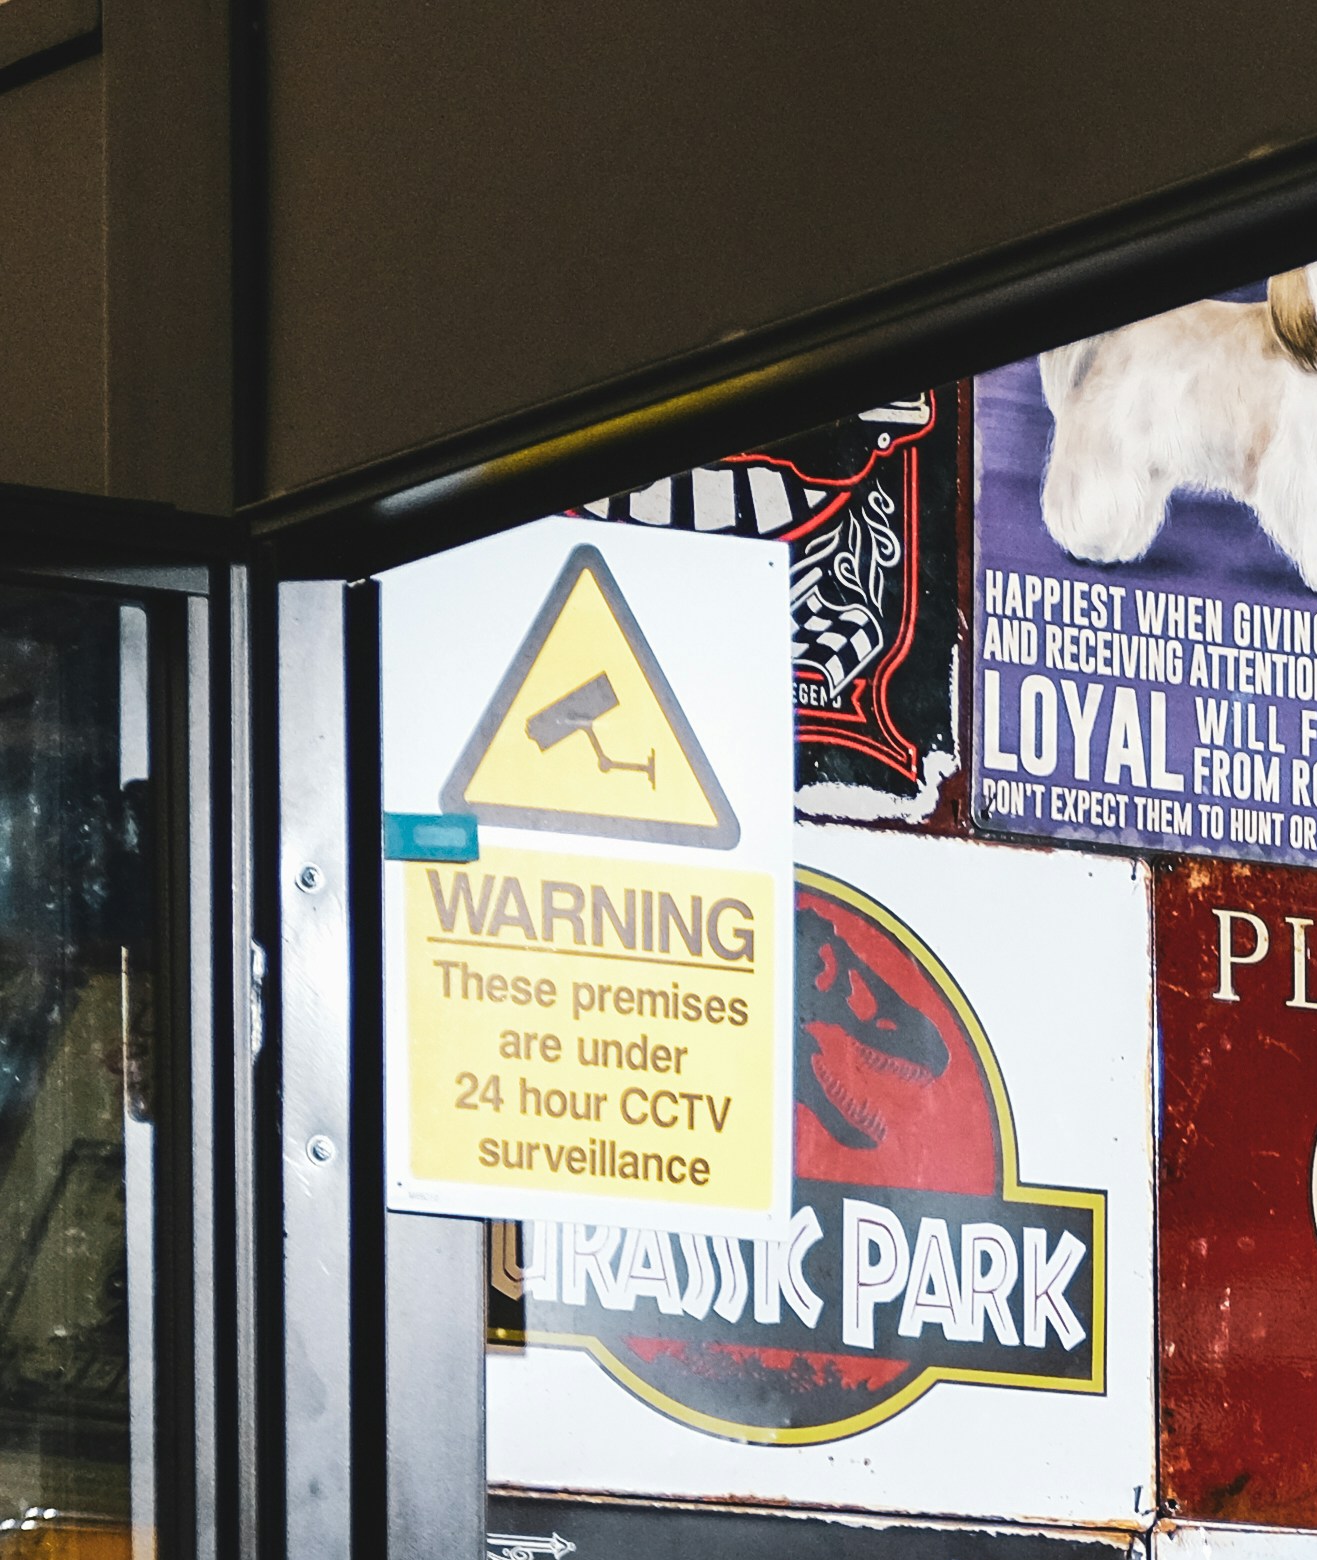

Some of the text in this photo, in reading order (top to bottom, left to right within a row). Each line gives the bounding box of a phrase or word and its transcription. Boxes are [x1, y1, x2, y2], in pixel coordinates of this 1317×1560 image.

[986, 569, 1126, 631] HAPPIEST
[1135, 588, 1223, 642] WHEN
[984, 617, 1038, 664] AND
[1045, 625, 1183, 684] RECEIVING
[983, 669, 1185, 792] LOYAL
[1195, 696, 1286, 754] WILL
[1194, 747, 1280, 802] FROM
[983, 778, 1046, 818] DON'T
[1051, 787, 1128, 829] EXPECT
[1133, 796, 1193, 837] THEM
[1199, 803, 1225, 841] TO
[1230, 808, 1283, 847] HUNT
[1289, 815, 1317, 850] OR
[426, 869, 755, 964] WARNING
[434, 959, 749, 1026] These premises
[499, 1029, 688, 1075] are under
[454, 1070, 731, 1134] 24 hour CCTV
[478, 1131, 711, 1187] surveillance
[842, 1198, 1087, 1351] PARK
